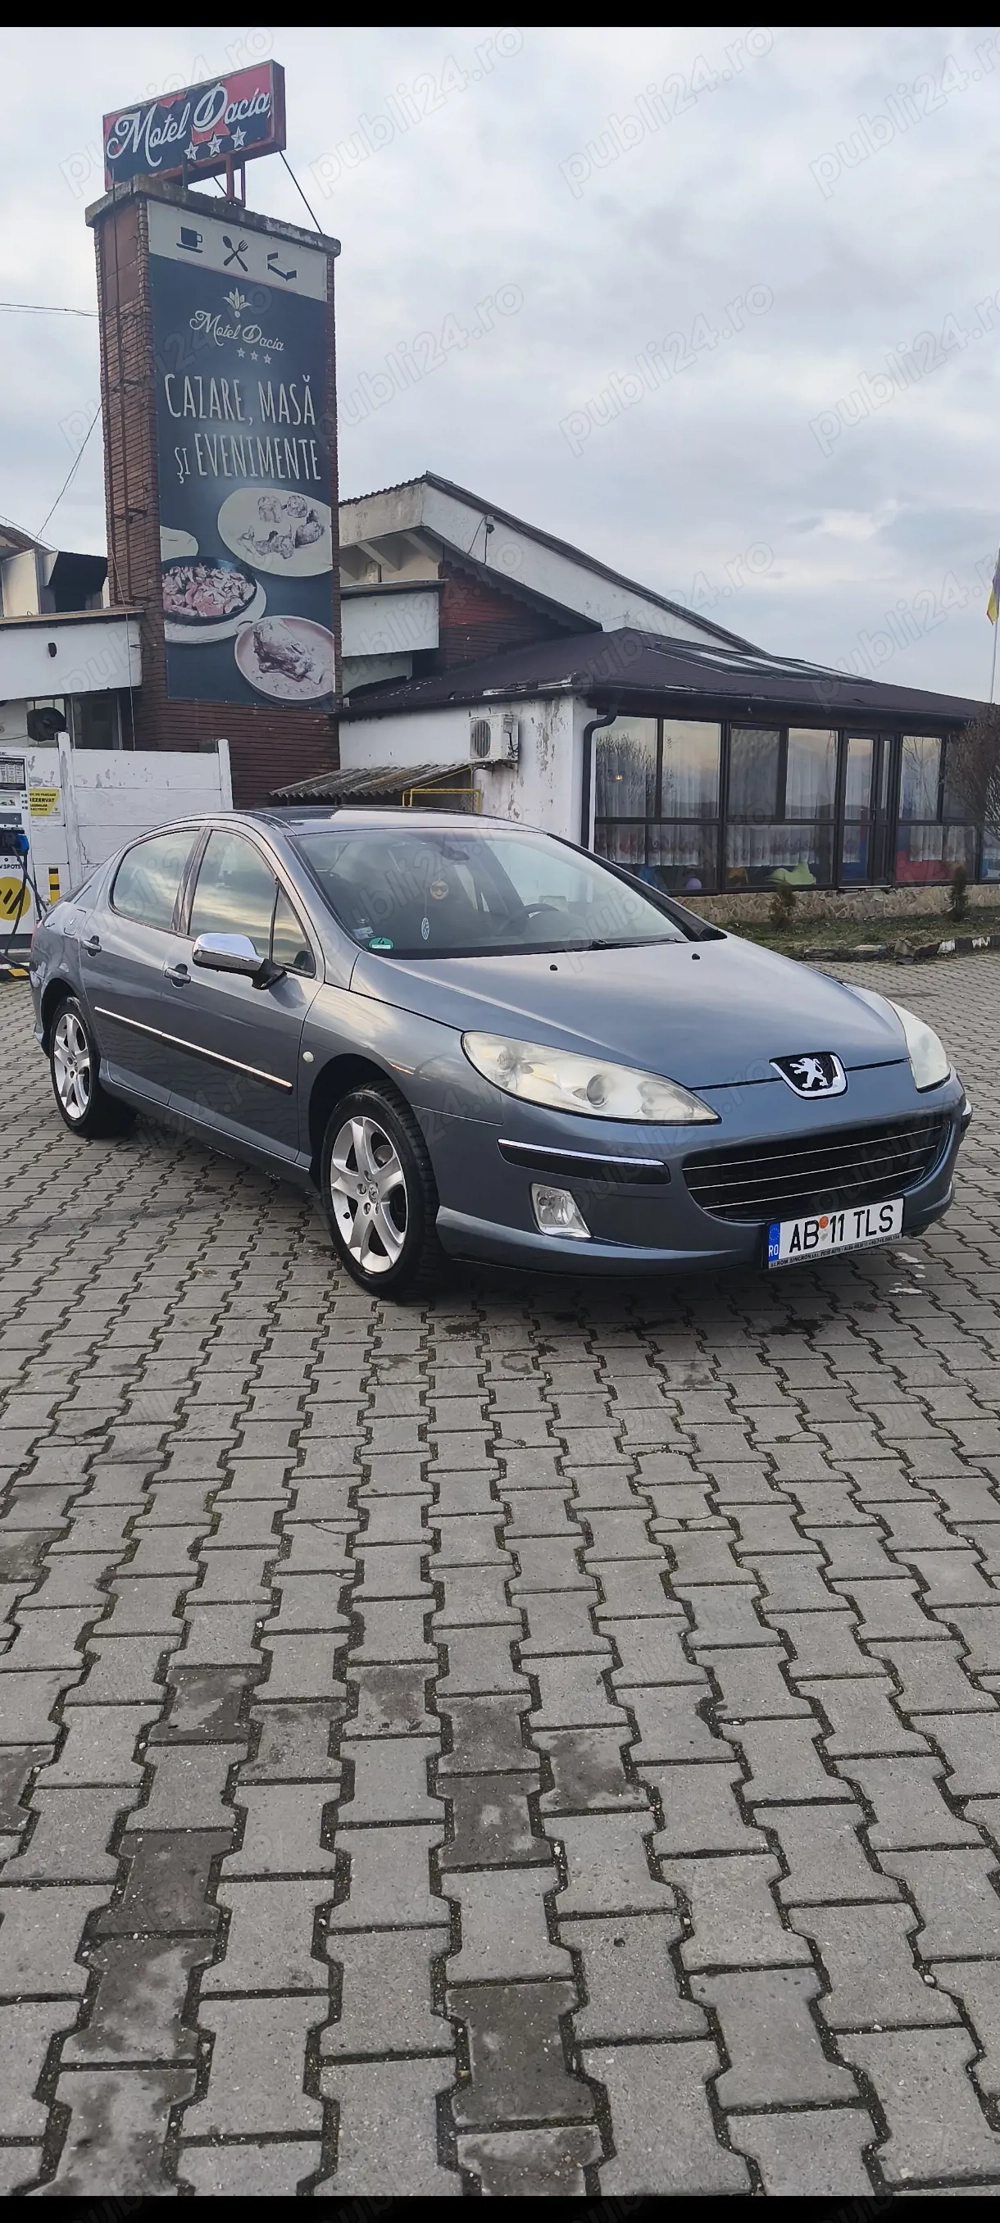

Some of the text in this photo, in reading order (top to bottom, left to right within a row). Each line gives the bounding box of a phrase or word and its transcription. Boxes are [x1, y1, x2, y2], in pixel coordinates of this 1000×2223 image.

[106, 82, 273, 167] Motel Dacia
[189, 310, 285, 351] Motel Dacia
[164, 373, 316, 426] CAZARE, MASĂ
[194, 433, 322, 480] EVENIMENTE
[768, 1244, 779, 1257] RO
[789, 1204, 894, 1253] AB 11 TLS
